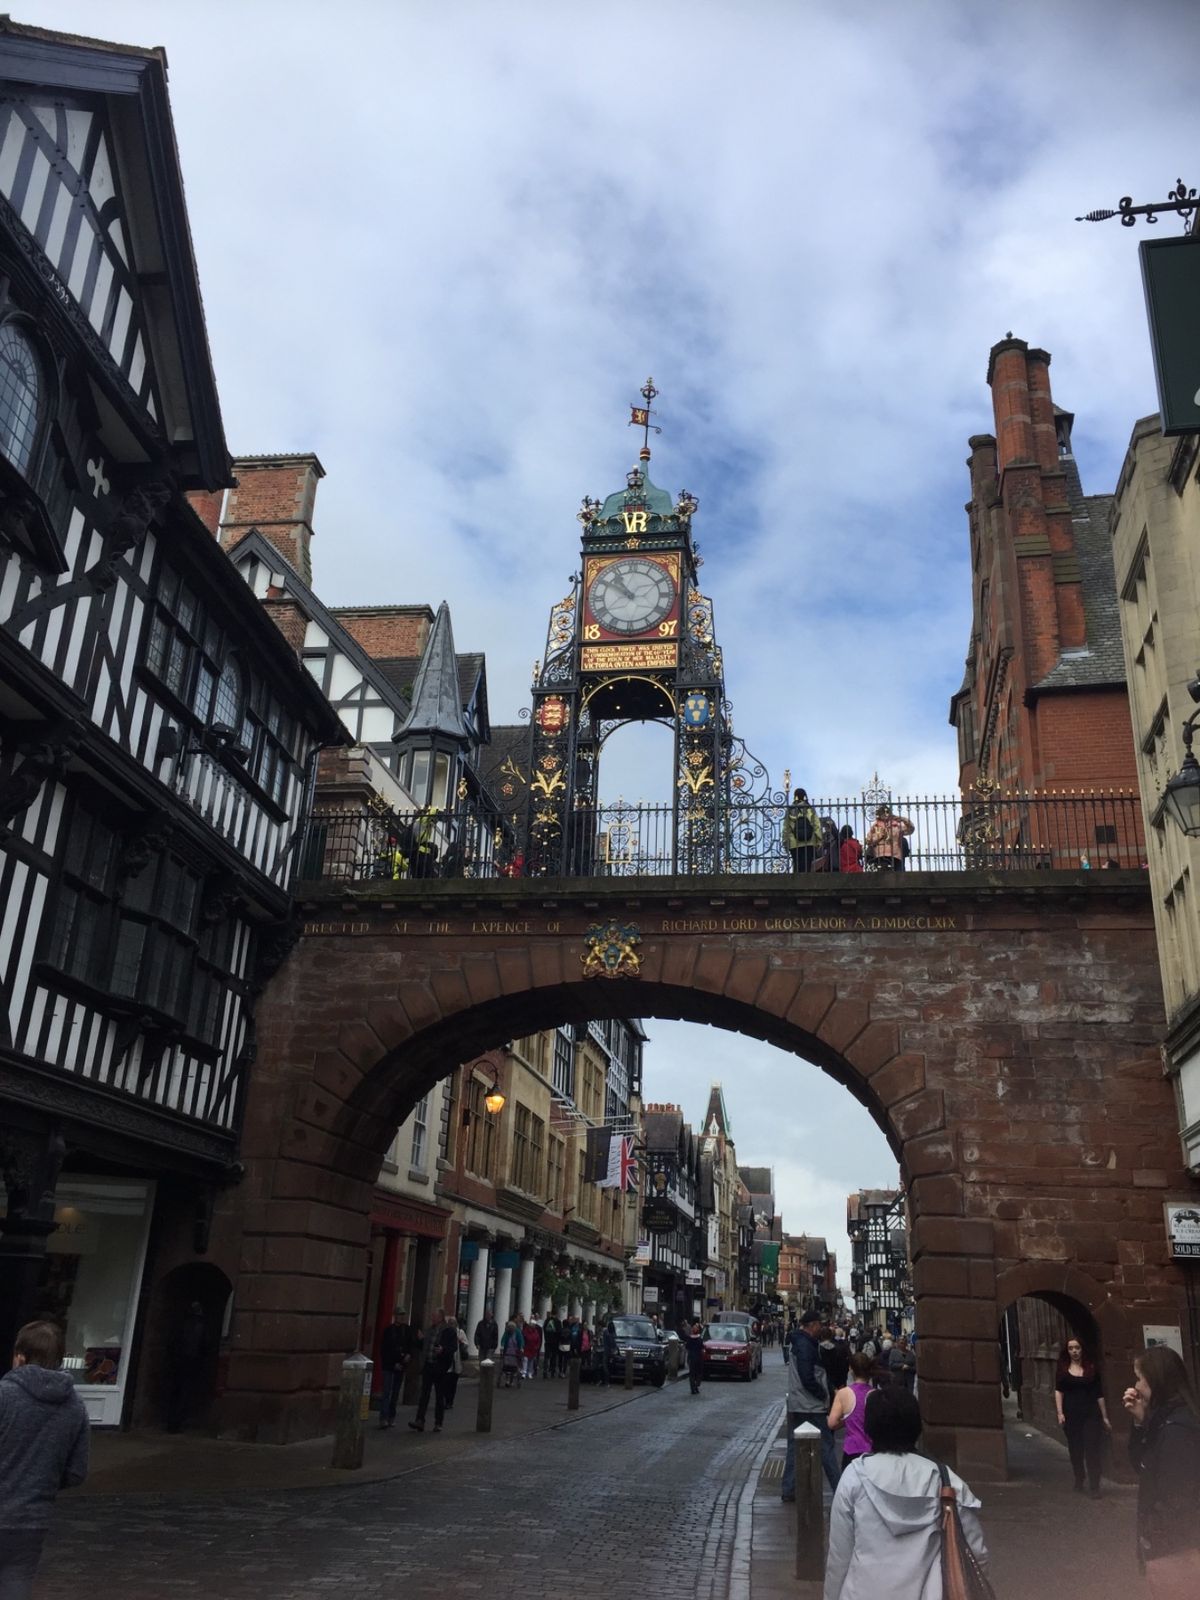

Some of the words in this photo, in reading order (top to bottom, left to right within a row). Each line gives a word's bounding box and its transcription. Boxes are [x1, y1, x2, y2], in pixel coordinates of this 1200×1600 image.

[622, 511, 648, 534] VR
[584, 623, 601, 640] 18
[658, 619, 678, 637] 97
[584, 661, 614, 669] VICTORIA
[647, 658, 676, 667] EMPRESS
[304, 922, 370, 934] ERECTED
[390, 922, 409, 933] AT
[428, 922, 452, 933] THE
[472, 921, 532, 933] EXPENCE
[547, 921, 564, 933] OF
[662, 920, 718, 932] RICHARD
[723, 919, 758, 931] LORD
[764, 917, 848, 930] GROSVENOR
[1175, 1244, 1192, 1255] SOLD
